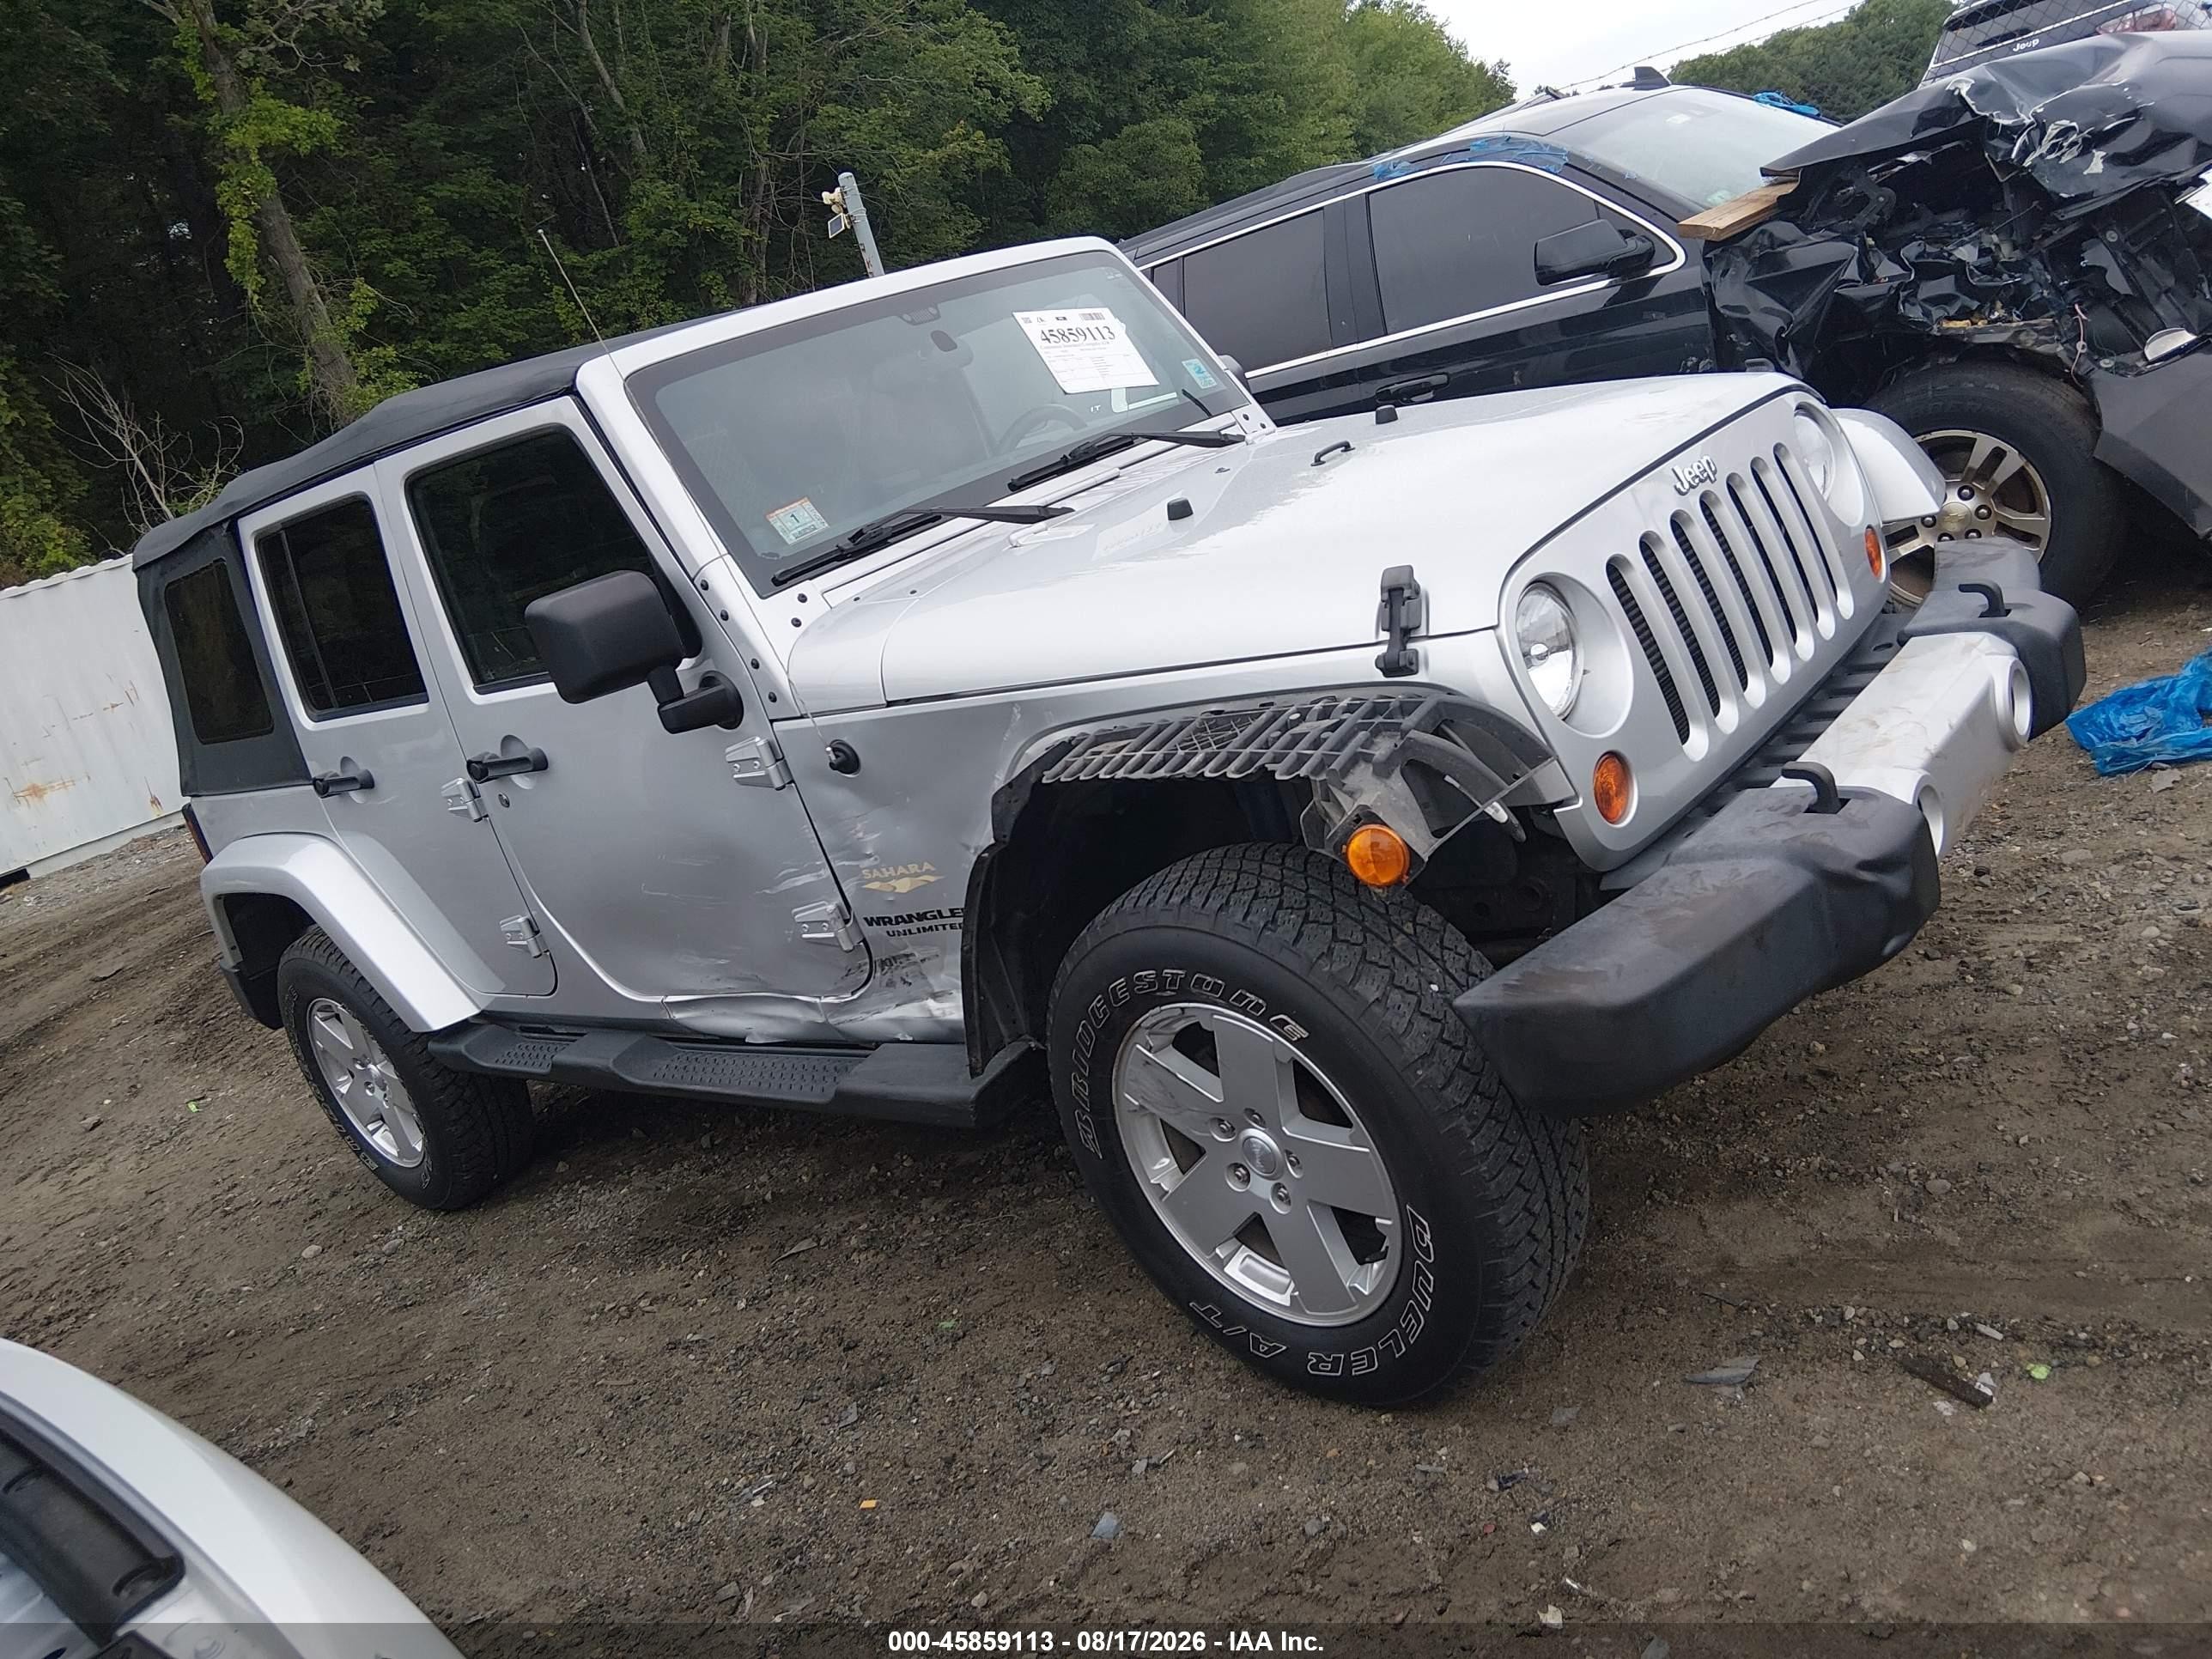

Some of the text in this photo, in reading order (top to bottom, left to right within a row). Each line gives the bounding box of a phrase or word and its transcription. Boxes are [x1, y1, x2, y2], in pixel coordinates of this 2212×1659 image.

[2012, 39, 2040, 52] Jeep
[1040, 325, 1115, 344] 45859113
[1672, 455, 1717, 495] Jeep
[861, 861, 936, 879] SAHARA
[863, 908, 964, 927] WRANGLE
[1071, 969, 1310, 1160] BRIDGESTONE
[1189, 1204, 1435, 1376] DUELER A/T
